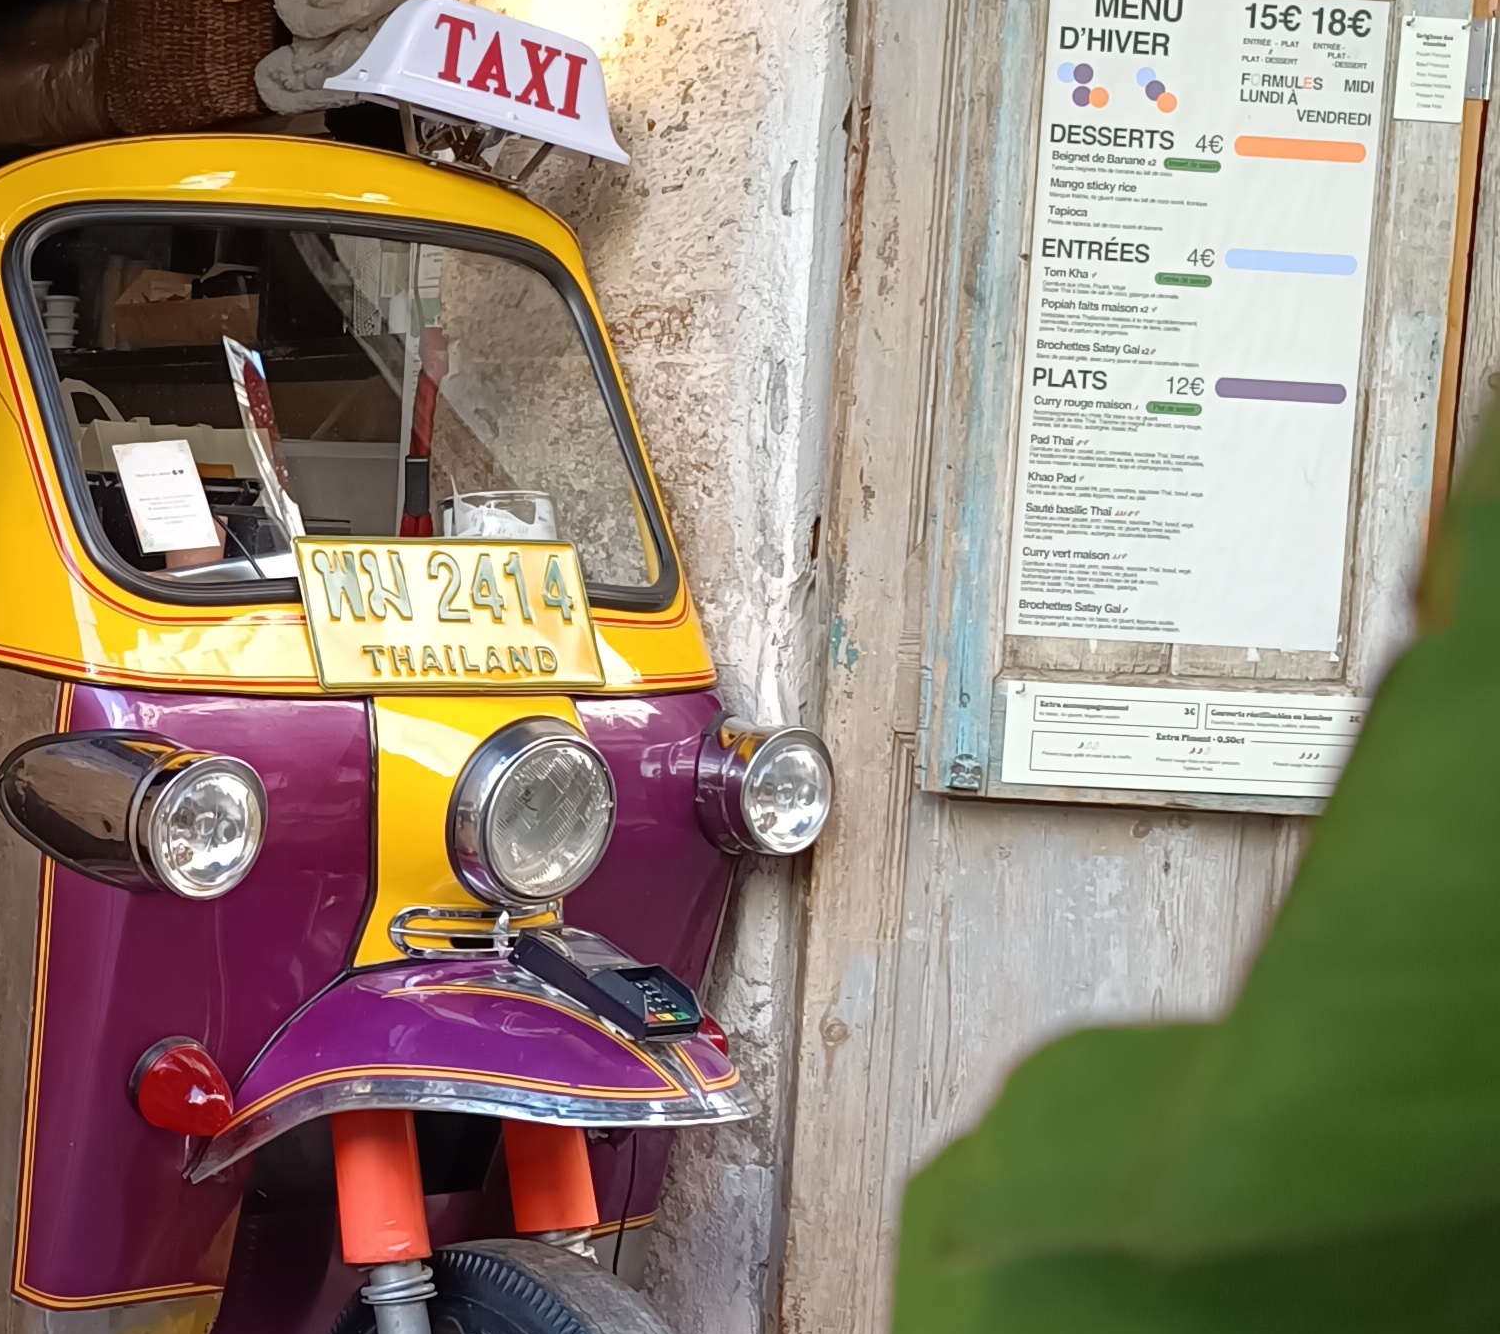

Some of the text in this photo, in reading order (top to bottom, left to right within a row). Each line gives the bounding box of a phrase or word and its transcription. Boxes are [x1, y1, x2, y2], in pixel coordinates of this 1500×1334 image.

[1245, 3, 1302, 32] 15€
[1312, 7, 1372, 38] 18€
[435, 13, 587, 120] TAXI
[1241, 72, 1375, 94] FORMULES MIDI
[1240, 88, 1299, 106] LUNDI À
[1296, 109, 1372, 126] VENDREDI
[1050, 123, 1224, 154] DESSERTS 4€
[1052, 150, 1090, 164] Beignet
[1092, 153, 1105, 163] de
[1107, 154, 1146, 166] Banane
[1050, 178, 1137, 193] Mango sticky rice
[1049, 205, 1088, 218] Tapioca
[1041, 237, 1215, 268] ENTRÉES 4€
[1044, 267, 1089, 279] Tom Kha
[1041, 298, 1076, 311] Popiah
[1078, 300, 1099, 311] faits
[1101, 302, 1139, 314] maison
[1036, 339, 1091, 353] Brochettes
[1093, 342, 1121, 355] Satay
[1032, 367, 1205, 397] PLATS 12€
[1034, 395, 1132, 410] Curry rouge maison
[1030, 434, 1050, 445] Pad
[1028, 471, 1076, 483] Khao Pad
[1026, 502, 1054, 514] Sauté
[1056, 505, 1088, 515] basilic
[1022, 546, 1110, 560] Curry vert maison
[427, 550, 575, 624] 2414
[1019, 599, 1072, 612] Brochettes
[1074, 602, 1102, 615] Satay
[362, 644, 558, 675] THAILAND
